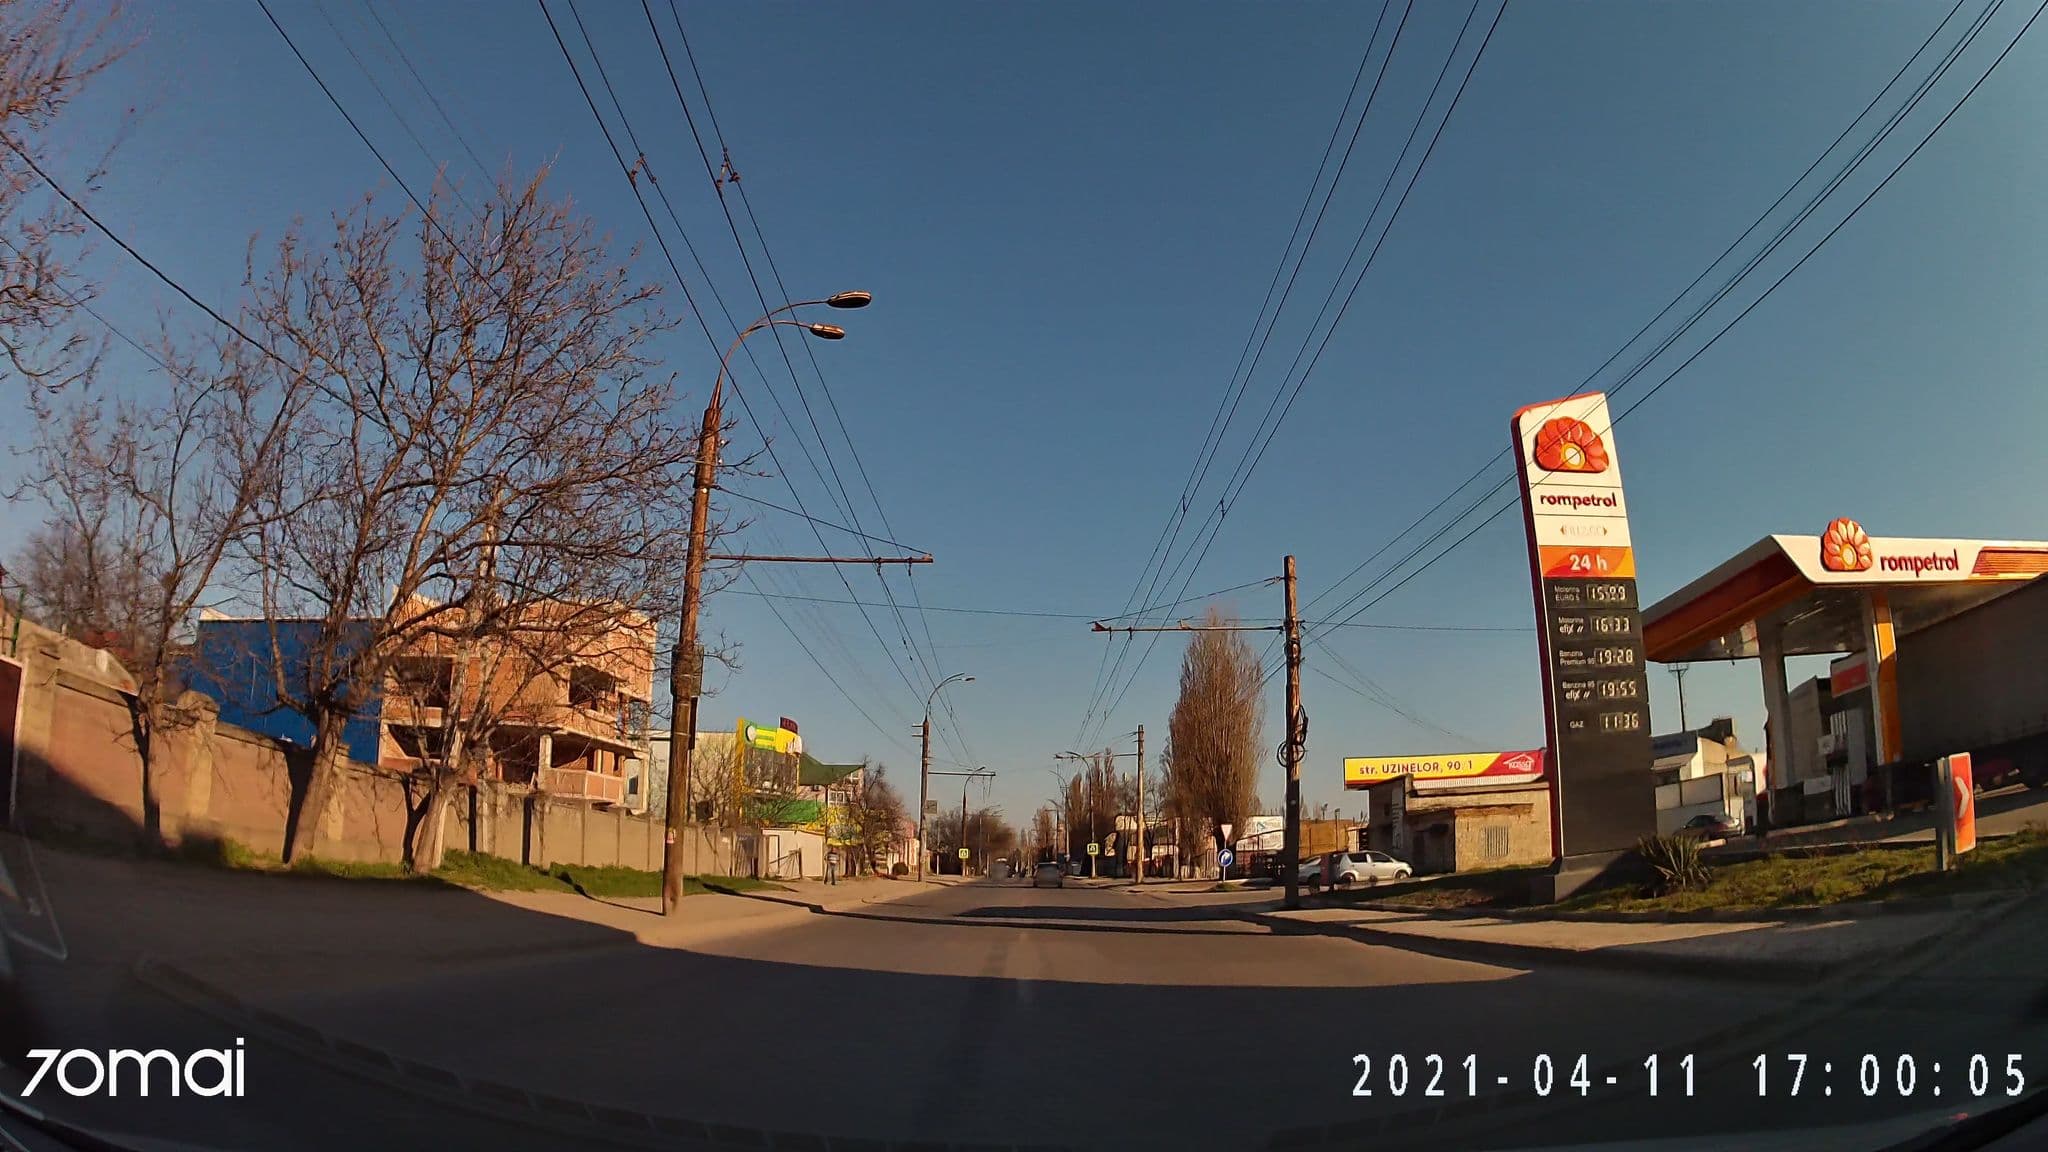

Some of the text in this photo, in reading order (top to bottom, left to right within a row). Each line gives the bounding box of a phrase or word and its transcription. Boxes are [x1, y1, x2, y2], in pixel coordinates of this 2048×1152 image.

[1540, 492, 1617, 509] rompetrol
[1569, 554, 1608, 571] 24 h
[1880, 549, 1959, 577] rompetrol
[1569, 721, 1584, 729] GAZ
[1359, 765, 1378, 775] str.
[1382, 763, 1444, 774] UZINELOR,
